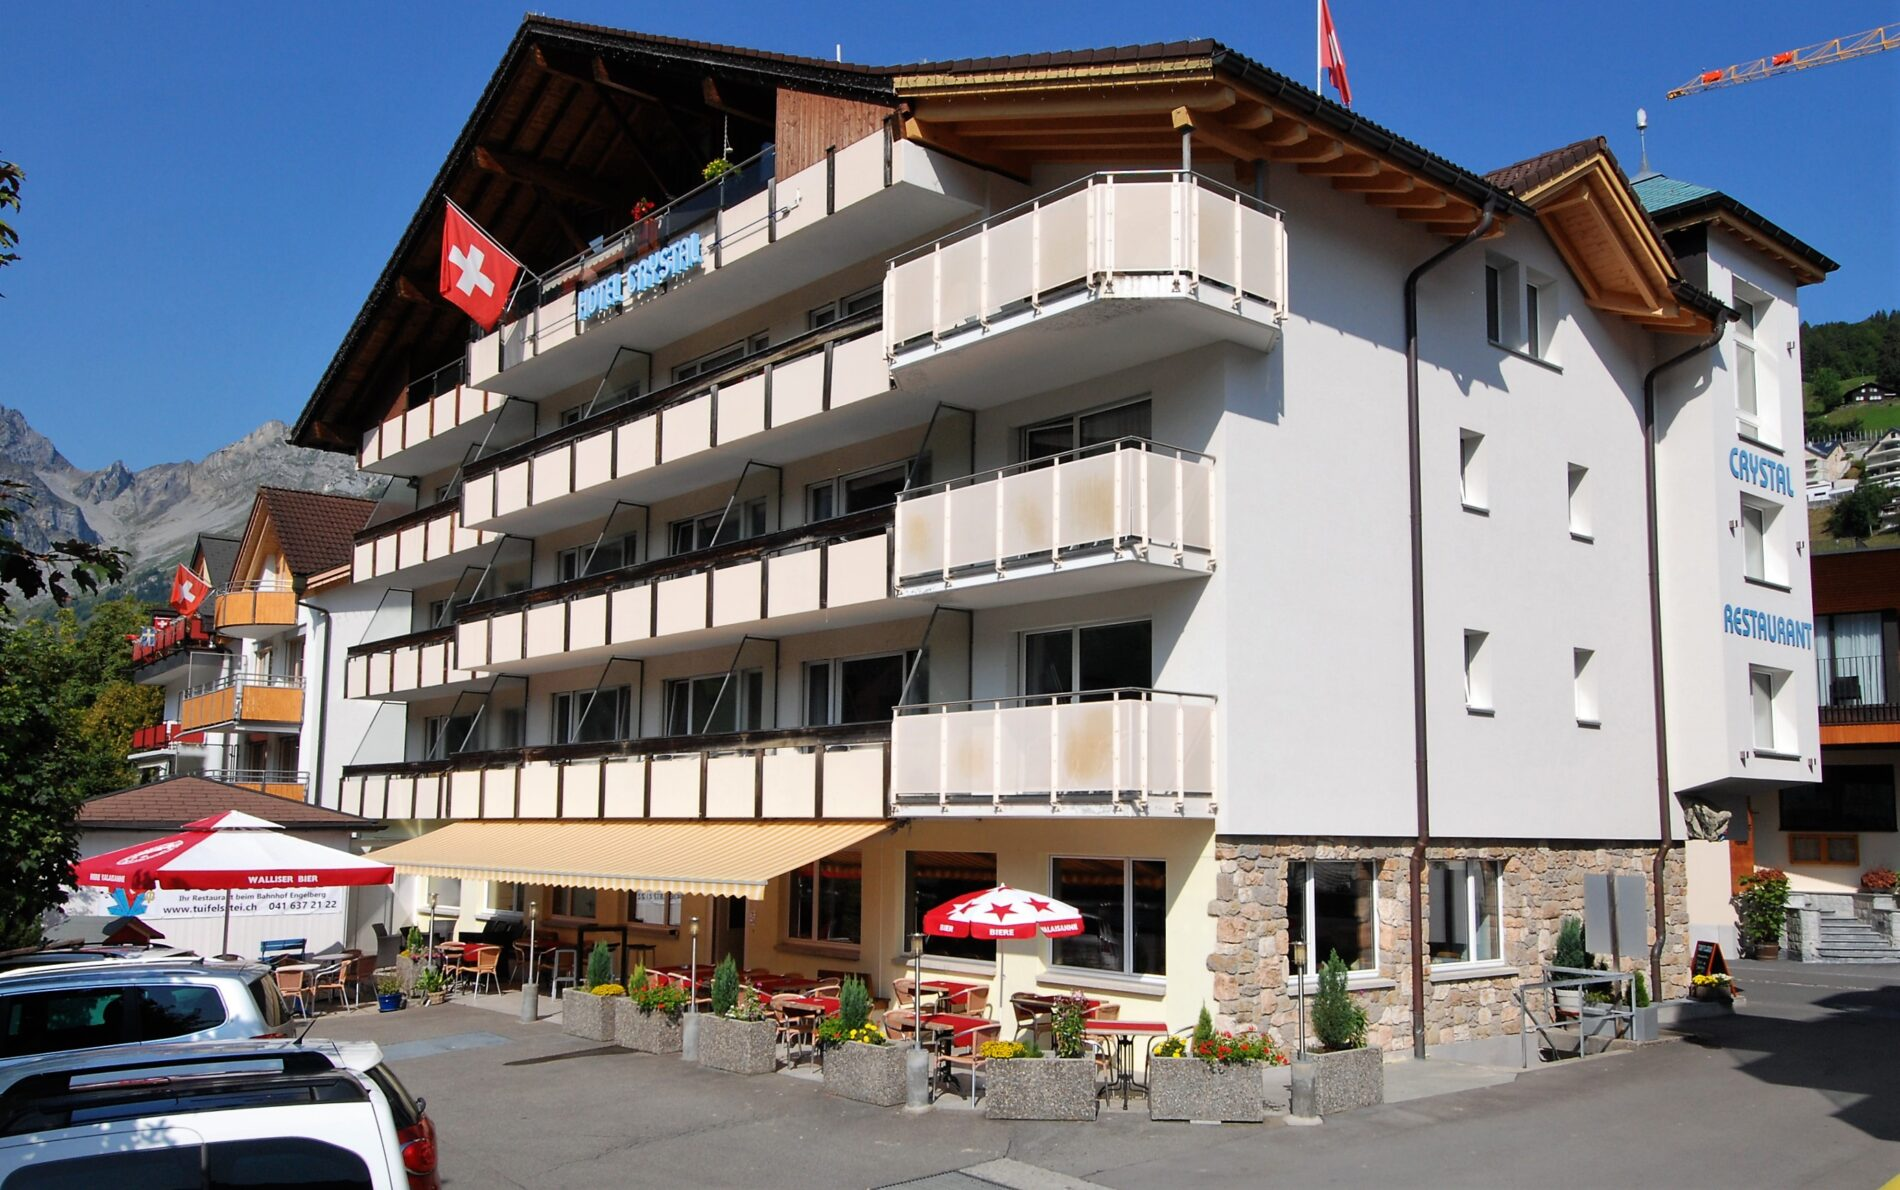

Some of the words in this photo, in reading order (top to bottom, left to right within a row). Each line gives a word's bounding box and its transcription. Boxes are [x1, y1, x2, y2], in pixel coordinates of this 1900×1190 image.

[577, 272, 624, 321] HOTEL
[627, 232, 704, 293] CRYSTAL
[1729, 447, 1794, 497] CRYSTAL
[1724, 603, 1812, 650] RESTAURANT
[248, 875, 293, 884] WALLISER
[298, 875, 318, 883] BIER
[163, 903, 257, 913] www.tuifelstei.ch
[268, 902, 286, 910] 041
[290, 901, 308, 909] 637
[310, 901, 322, 909] 21
[325, 900, 337, 908] 22
[290, 891, 326, 899] Engelberg
